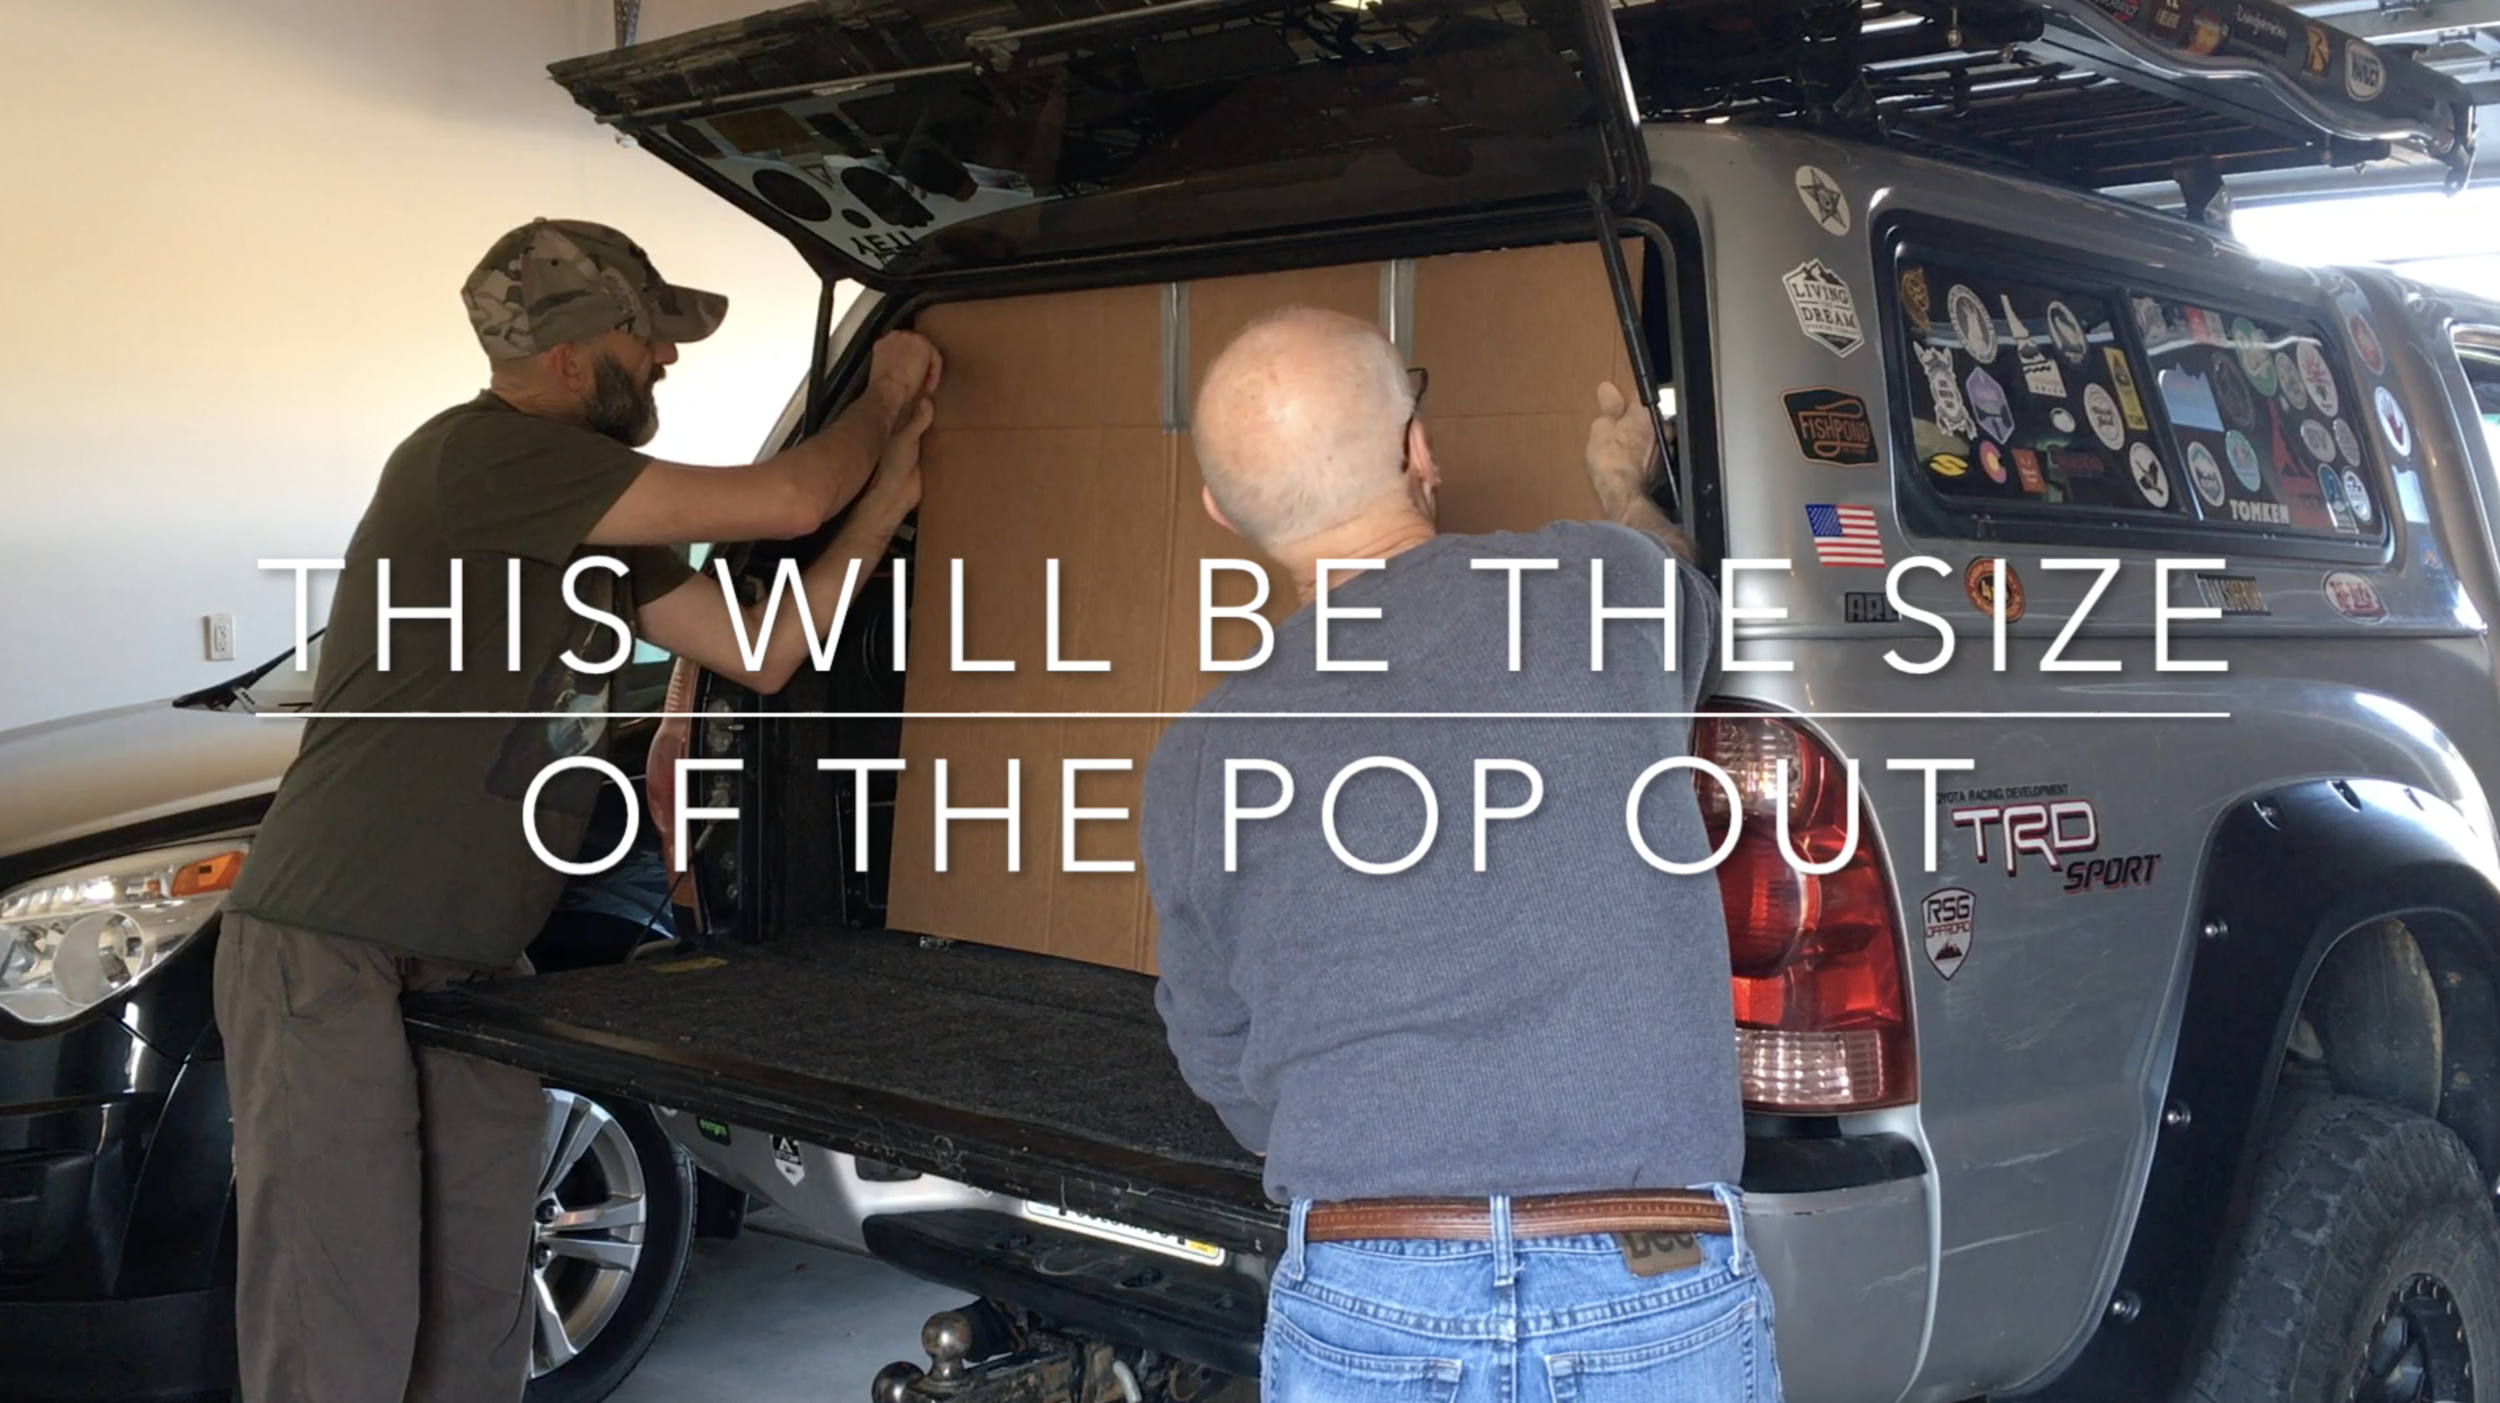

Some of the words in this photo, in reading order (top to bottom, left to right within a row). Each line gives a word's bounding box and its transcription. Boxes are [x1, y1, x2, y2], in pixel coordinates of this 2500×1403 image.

[1792, 282, 1850, 304] LIVING
[1801, 306, 1858, 328] DREAM
[1798, 404, 1870, 452] FISHPOND
[2229, 499, 2290, 525] TOMKEN
[1937, 791, 1965, 804] OYOTA
[1968, 788, 2003, 801] RACING
[2005, 783, 2069, 799] DEVELOPMENT
[1951, 799, 2100, 877] TRD
[2063, 854, 2162, 894] SPORT
[1926, 894, 1971, 924] RSG
[1925, 920, 1971, 938] OFFROAD
